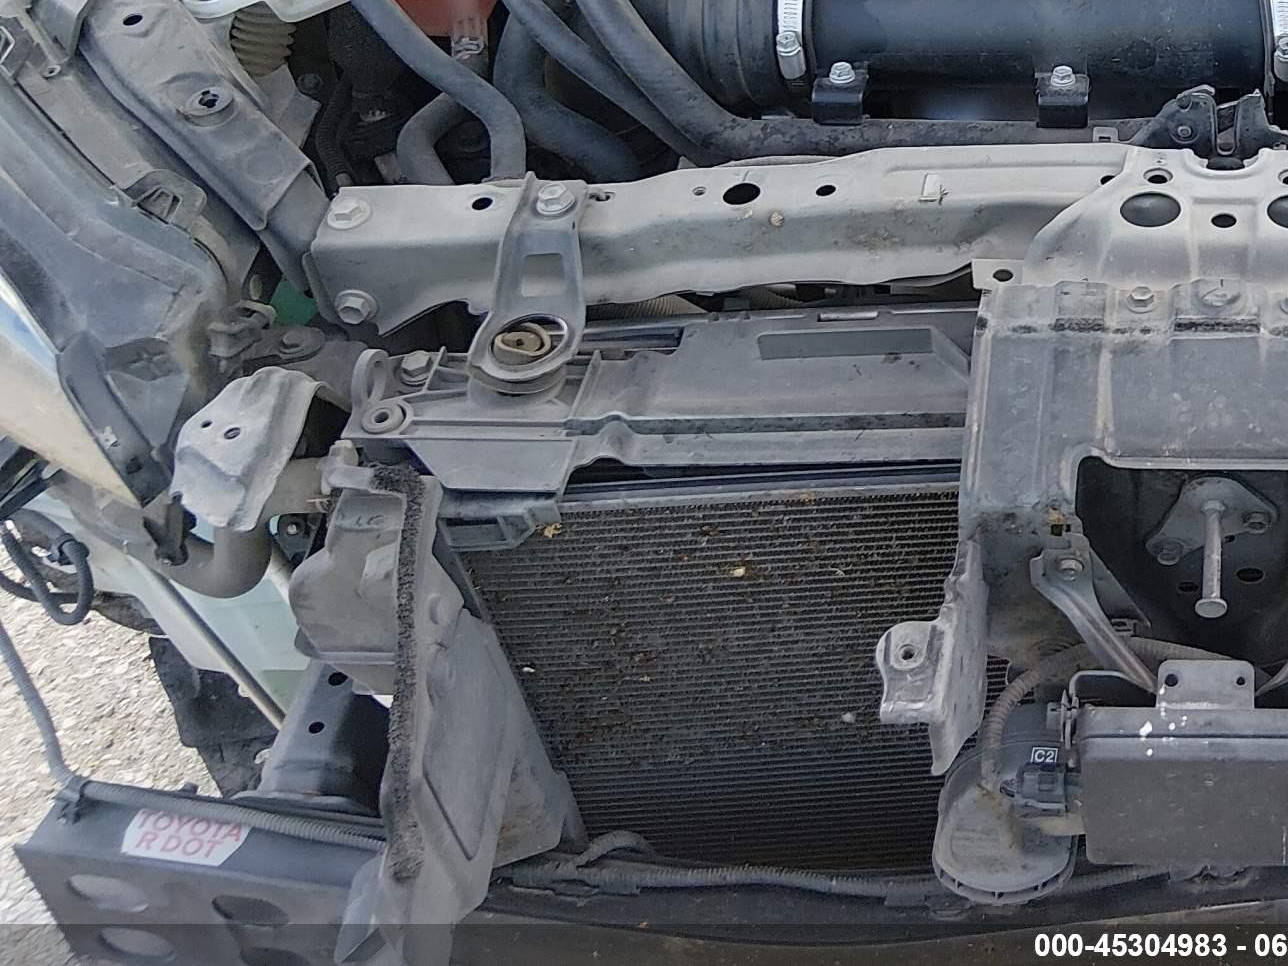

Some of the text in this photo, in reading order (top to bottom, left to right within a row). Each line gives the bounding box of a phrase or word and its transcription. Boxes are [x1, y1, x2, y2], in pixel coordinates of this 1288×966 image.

[1034, 749, 1055, 763] C2
[137, 809, 242, 842] TOYOTA
[135, 831, 224, 859] R DOT
